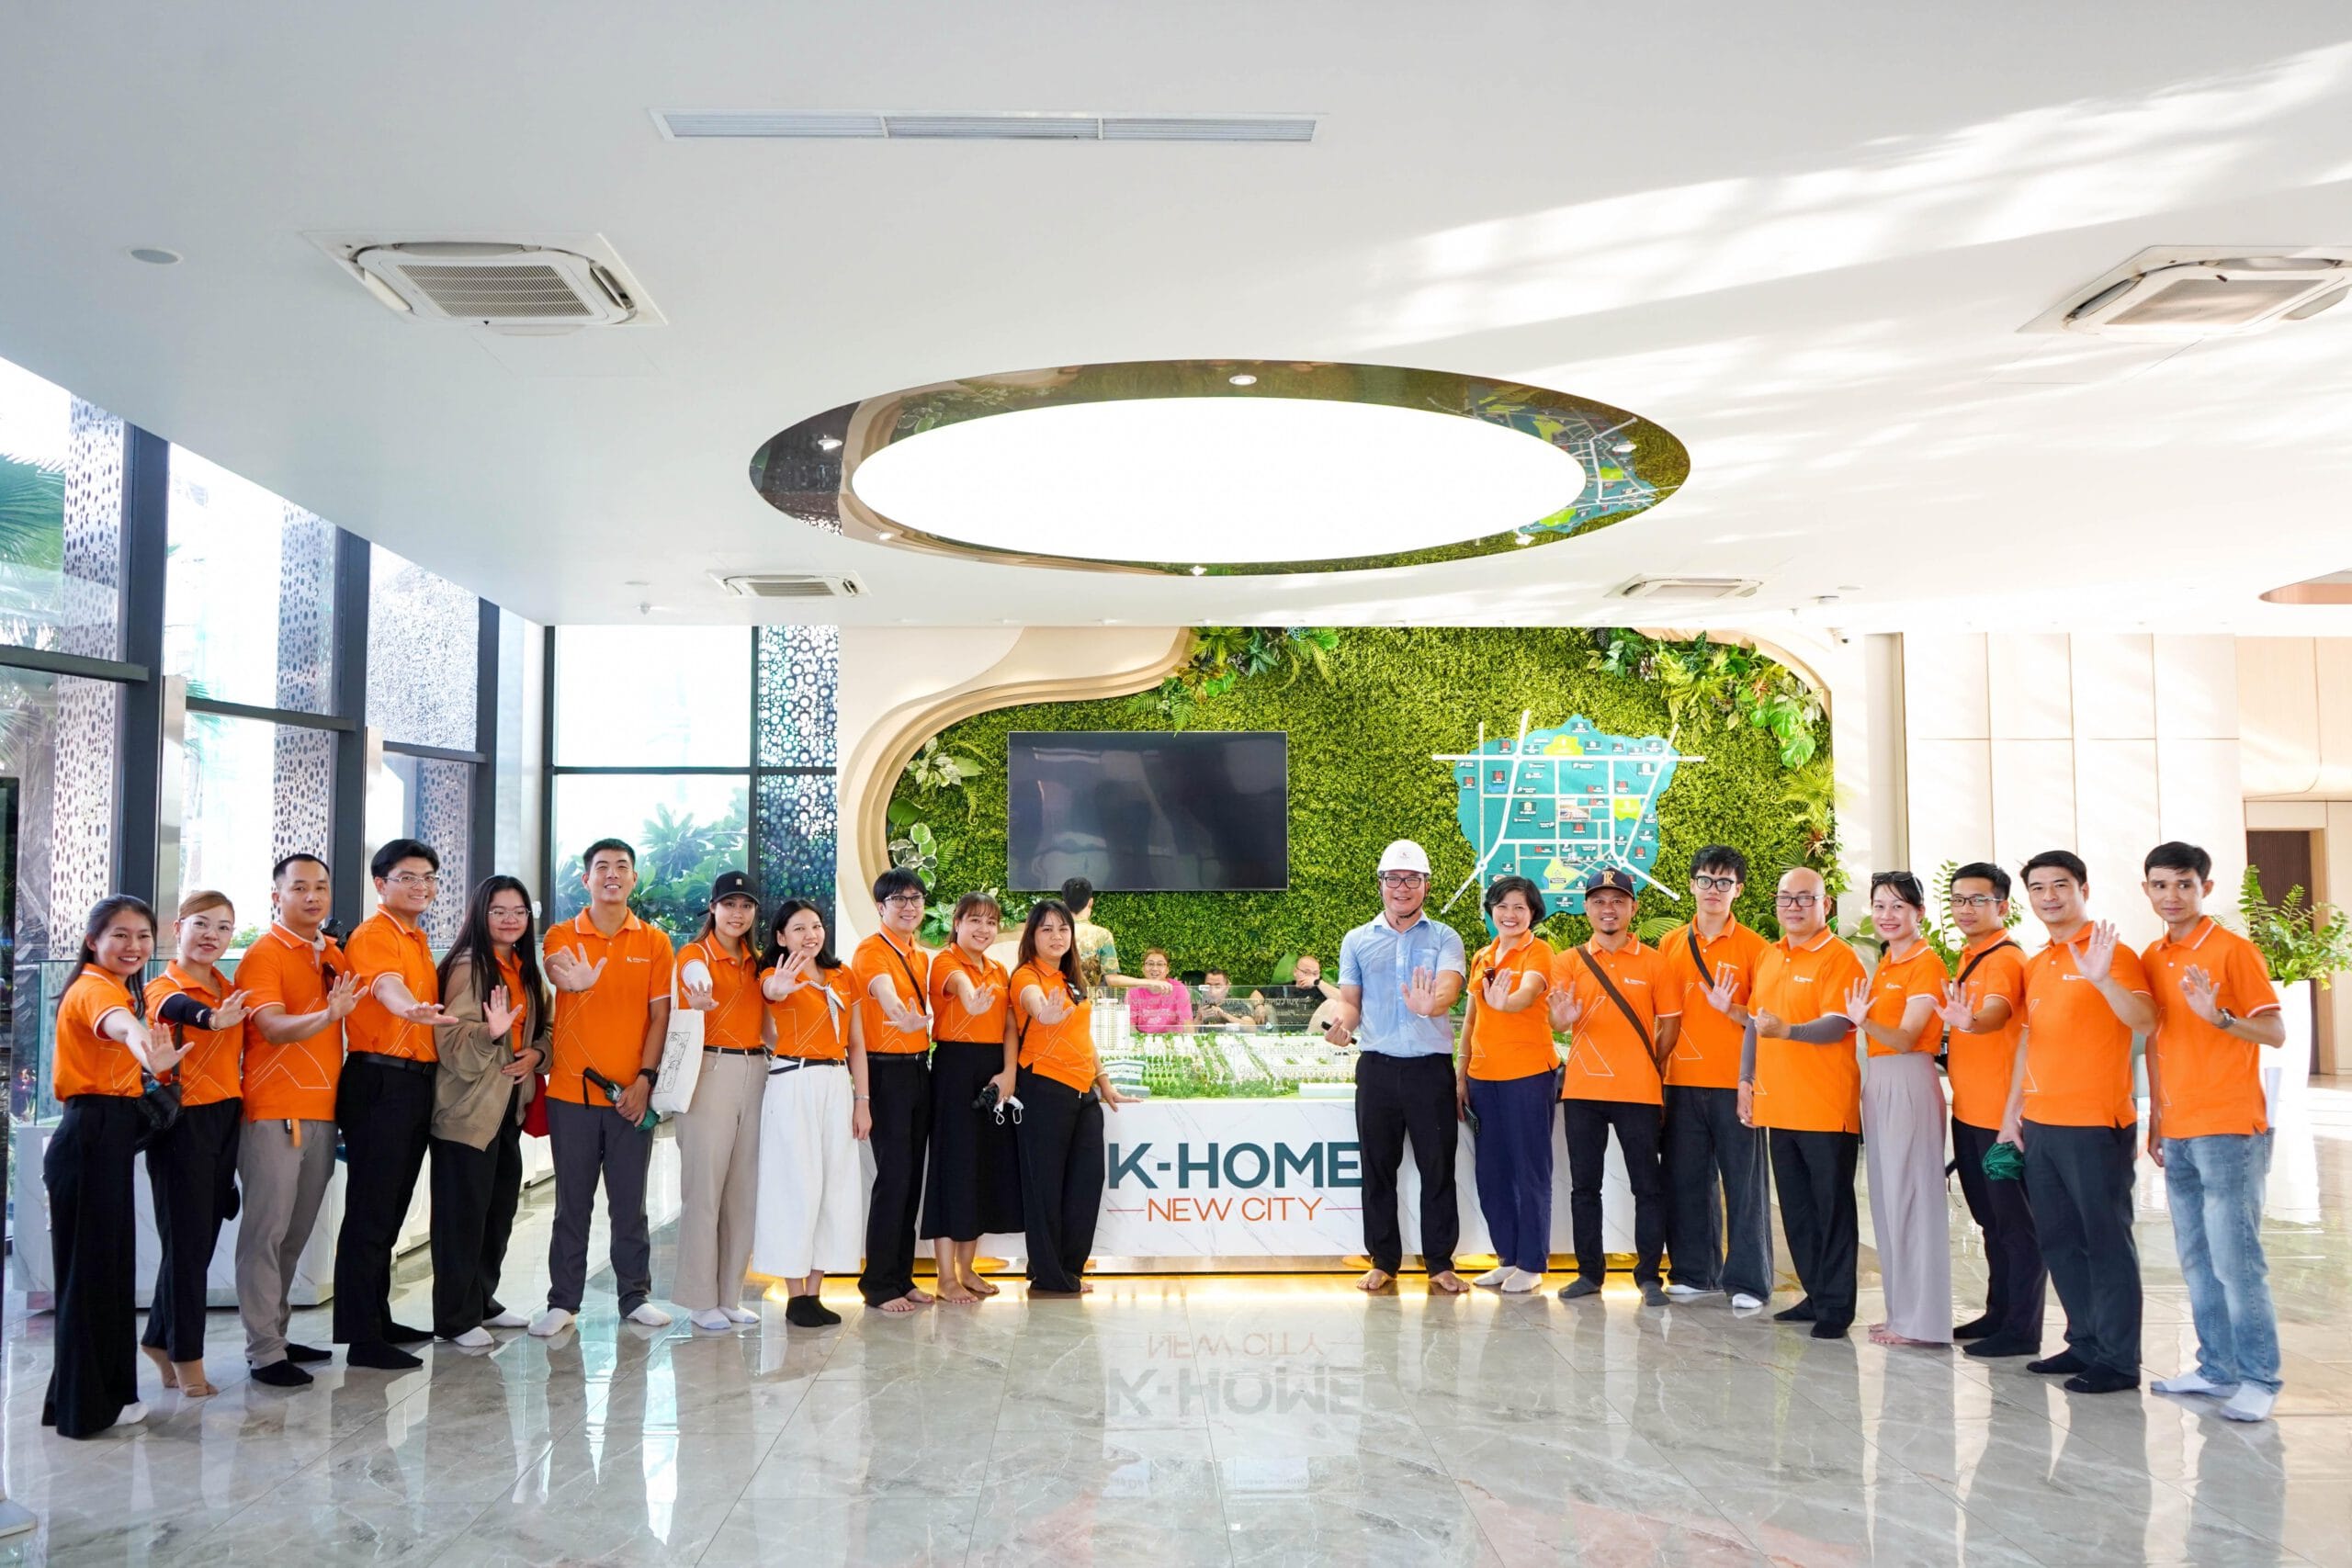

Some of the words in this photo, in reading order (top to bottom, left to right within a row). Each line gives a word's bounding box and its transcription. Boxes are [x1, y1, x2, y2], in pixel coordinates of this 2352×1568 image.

[1108, 1142, 1363, 1189] K-HOME
[1148, 1197, 1233, 1222] NEW
[1241, 1197, 1323, 1221] CITY
